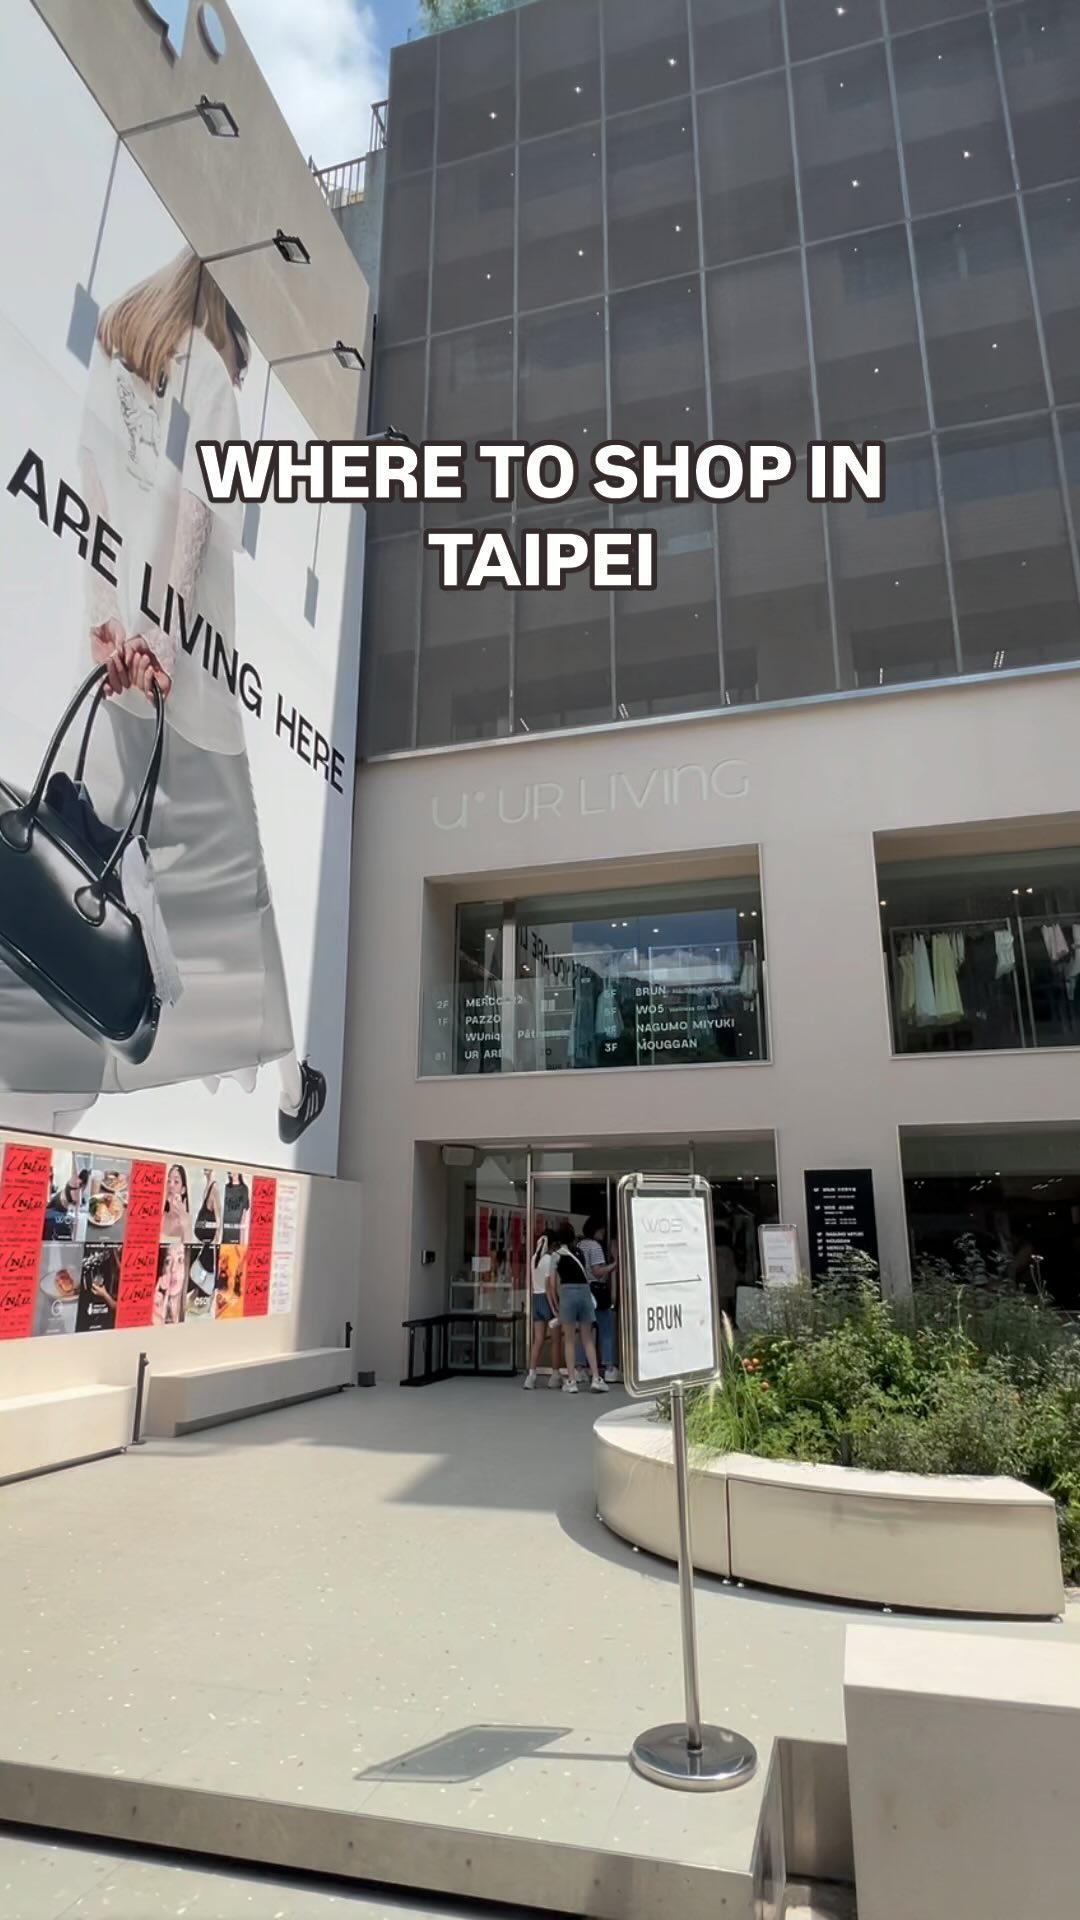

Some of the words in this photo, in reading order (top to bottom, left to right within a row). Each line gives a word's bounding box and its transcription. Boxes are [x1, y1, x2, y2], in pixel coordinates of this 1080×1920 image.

[7, 448, 123, 587] ARE
[140, 562, 263, 718] LIVING
[276, 694, 345, 794] HERE
[498, 782, 564, 824] UR
[635, 986, 667, 998] BRUN
[436, 1000, 449, 1010] 2F
[437, 1017, 449, 1028] 1F
[465, 1015, 502, 1026] PAZZO
[635, 1021, 689, 1034] NAGUMO
[692, 1018, 736, 1031] MIYUKI
[604, 1042, 618, 1053] 3F
[636, 1038, 699, 1052] MOUGGAN
[647, 1304, 683, 1332] BRUN
